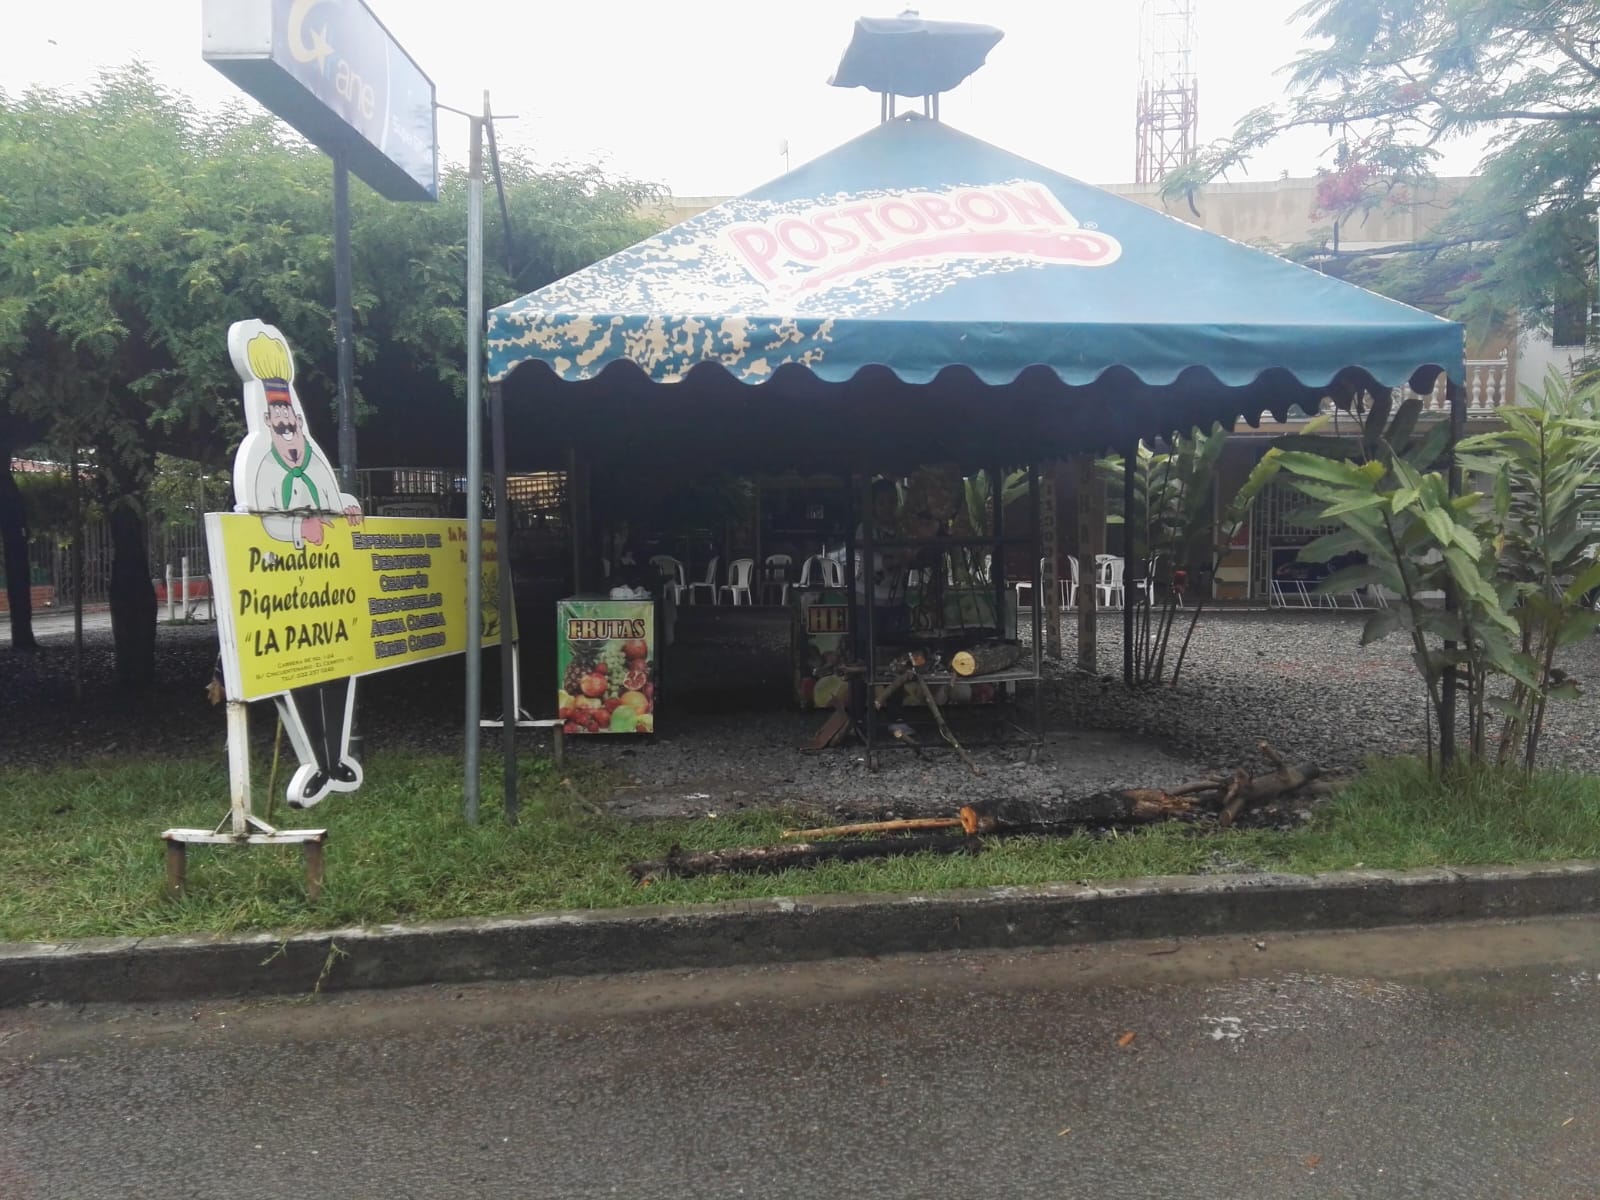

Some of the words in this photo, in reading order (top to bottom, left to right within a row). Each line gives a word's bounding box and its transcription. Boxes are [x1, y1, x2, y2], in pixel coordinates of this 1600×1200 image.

[728, 182, 1067, 280] POSTOBON
[249, 544, 340, 573] Panadería
[238, 582, 356, 620] Piqueteadero
[567, 618, 645, 640] FRUTAS
